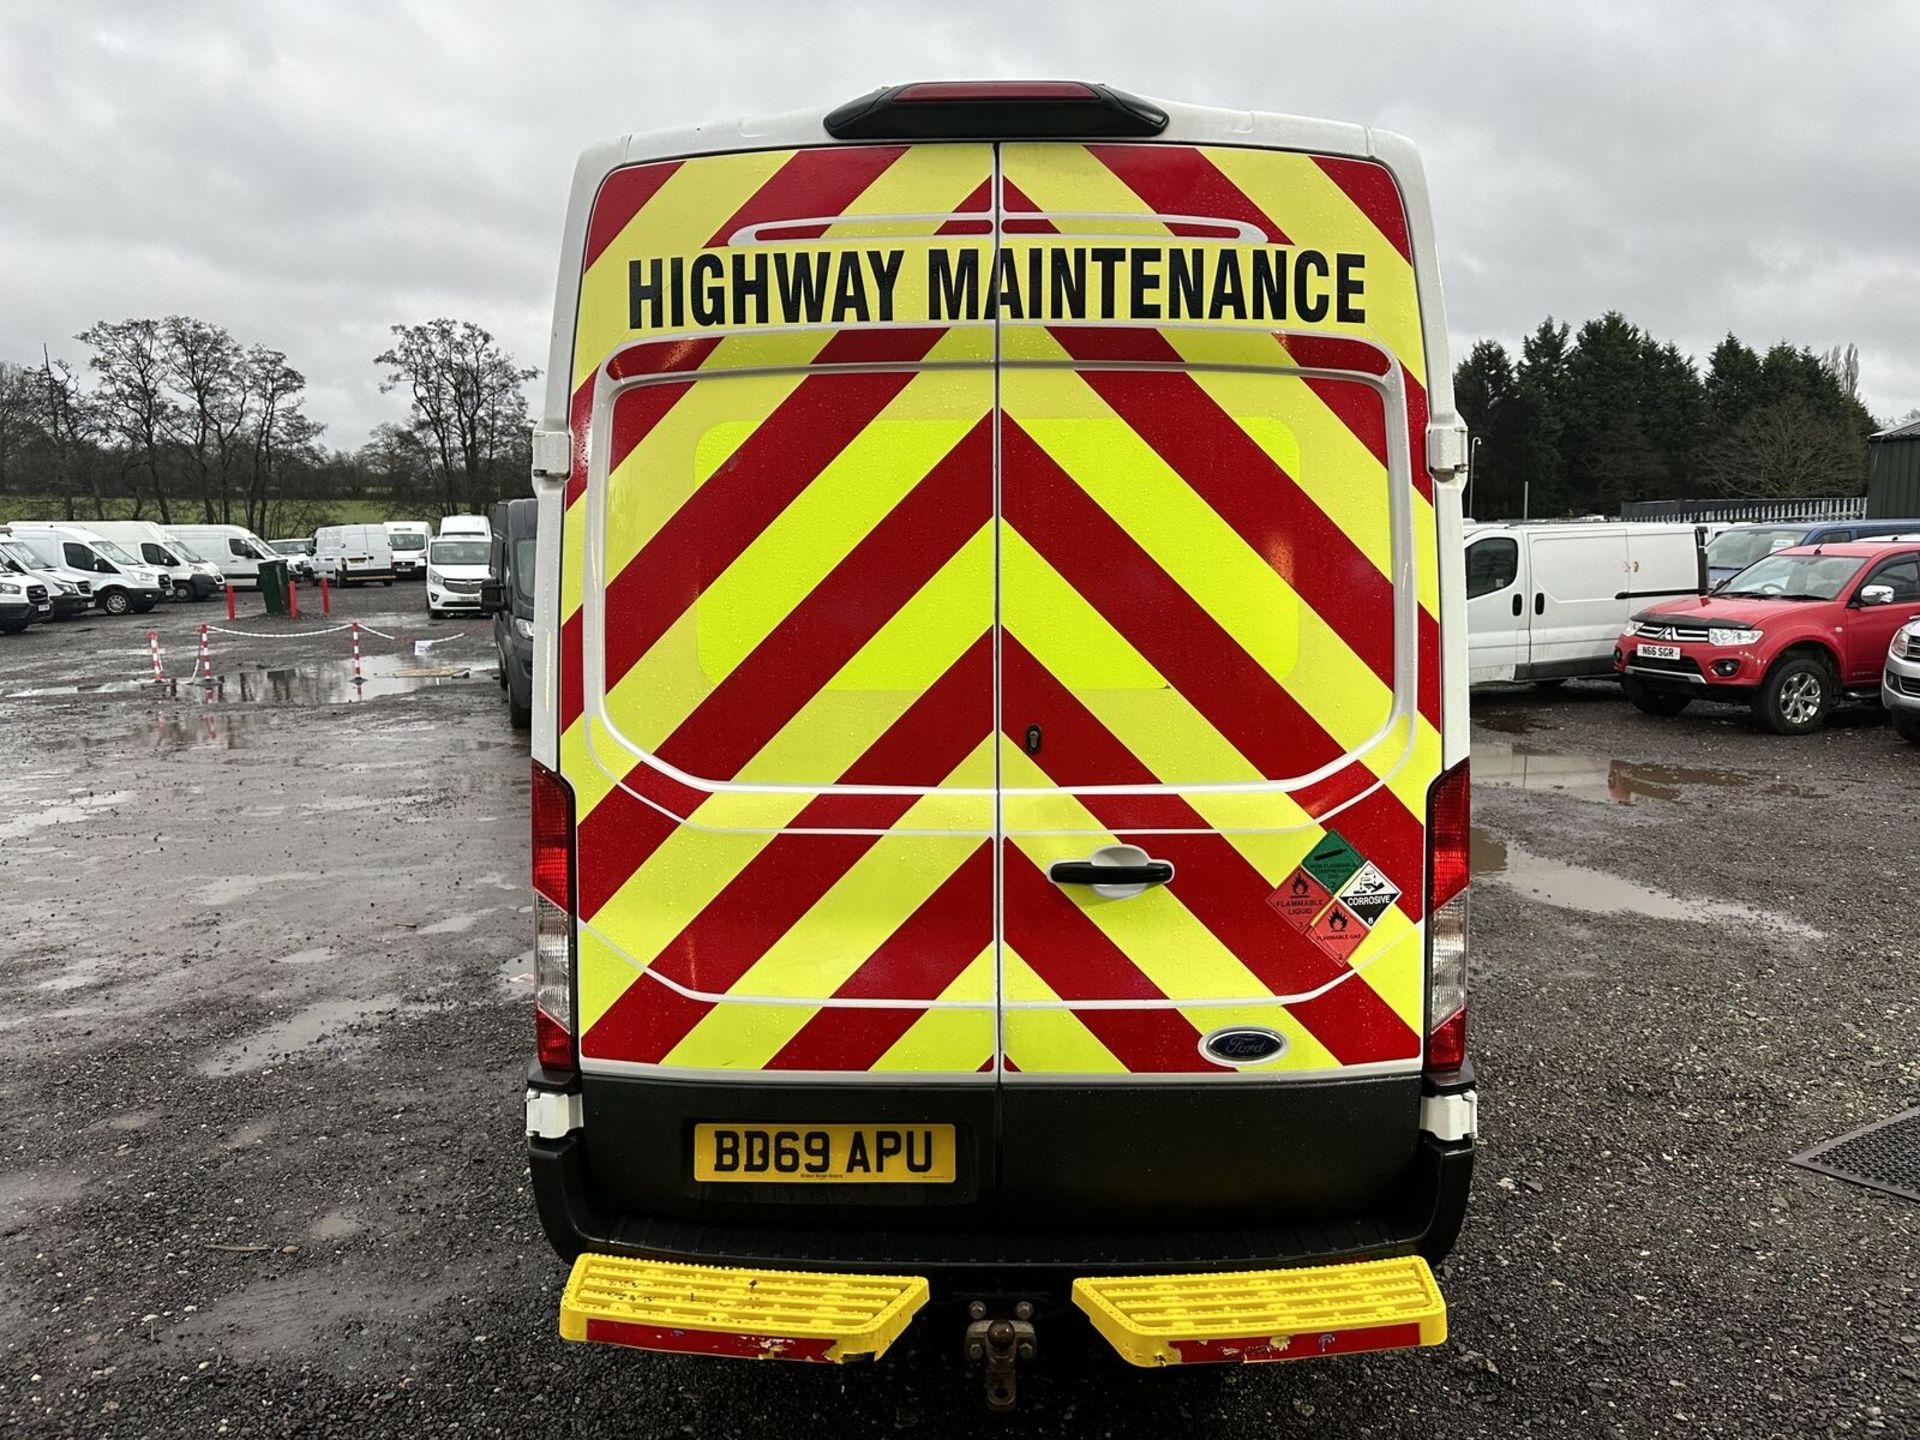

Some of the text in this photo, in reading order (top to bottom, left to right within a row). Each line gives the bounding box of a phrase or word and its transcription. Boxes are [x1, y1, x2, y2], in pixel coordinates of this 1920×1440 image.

[628, 248, 1366, 329] HIGHWAY MAINTENANCE
[1642, 646, 1674, 658] N66 SGR
[1276, 899, 1323, 907] FLAMMABLE
[1347, 895, 1391, 906] CORROSIVE
[1287, 907, 1313, 915] LIQUID
[1226, 1036, 1266, 1054] Ford
[714, 1130, 932, 1173] BD69 APU
